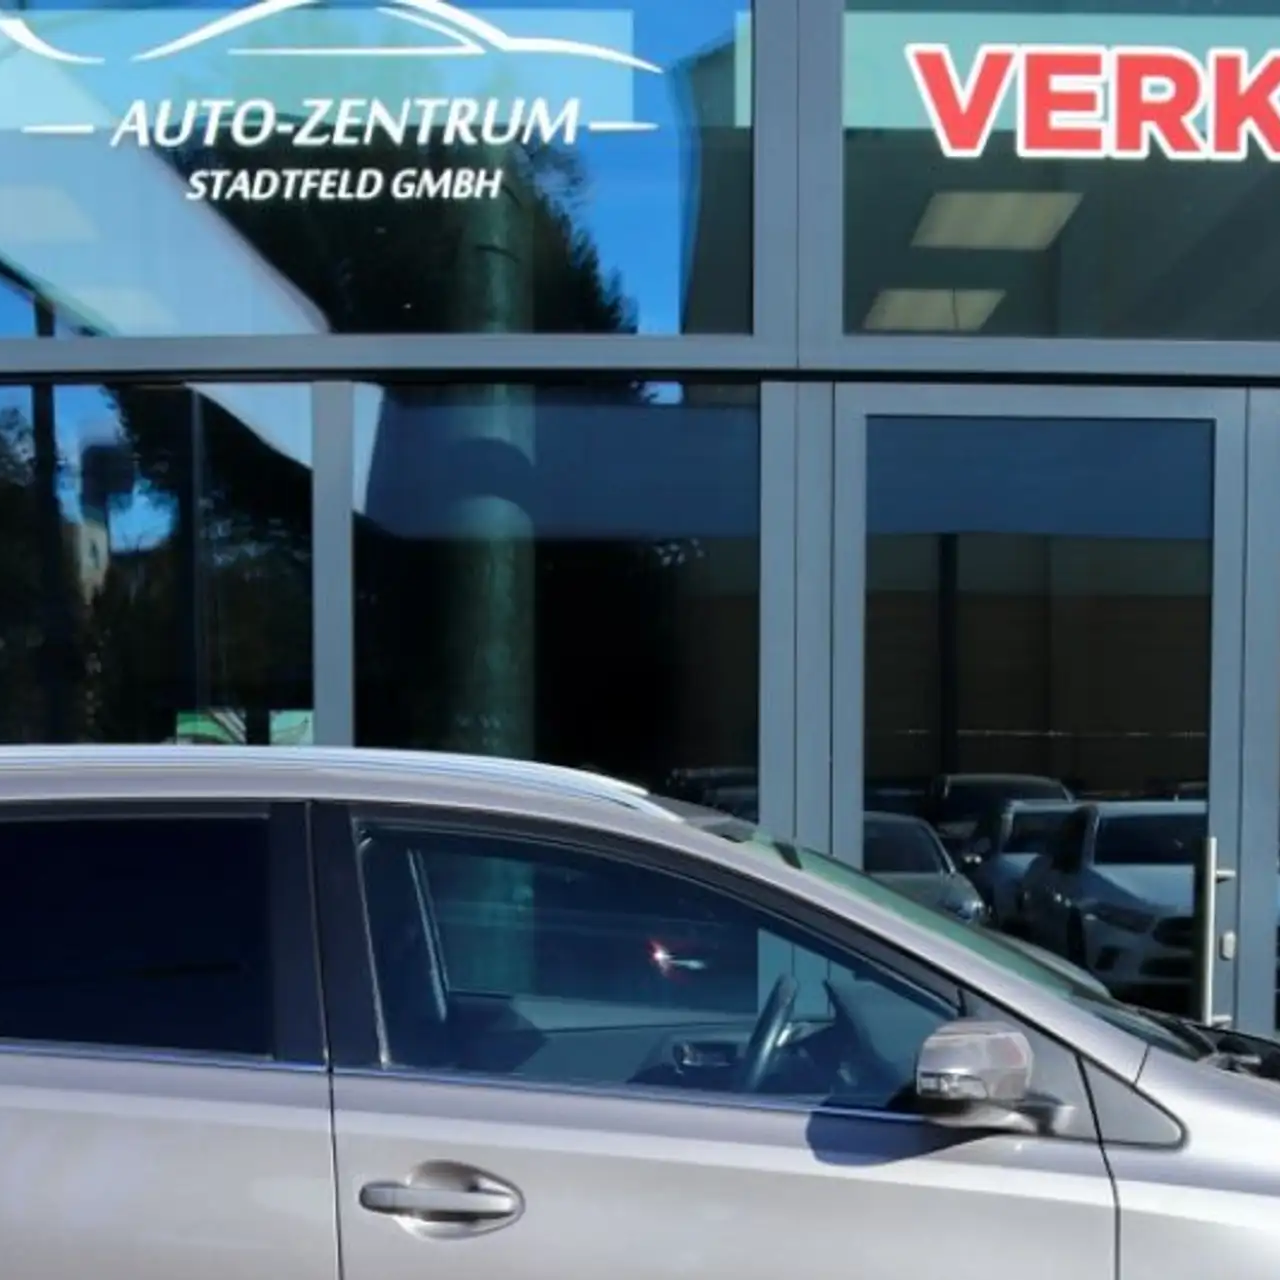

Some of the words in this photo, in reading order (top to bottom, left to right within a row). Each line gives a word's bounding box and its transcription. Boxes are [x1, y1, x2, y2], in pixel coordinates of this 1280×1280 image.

[111, 97, 581, 148] AUTO-ZENTRUM
[186, 168, 382, 201] STADTFELD
[391, 169, 503, 200] GMBH
